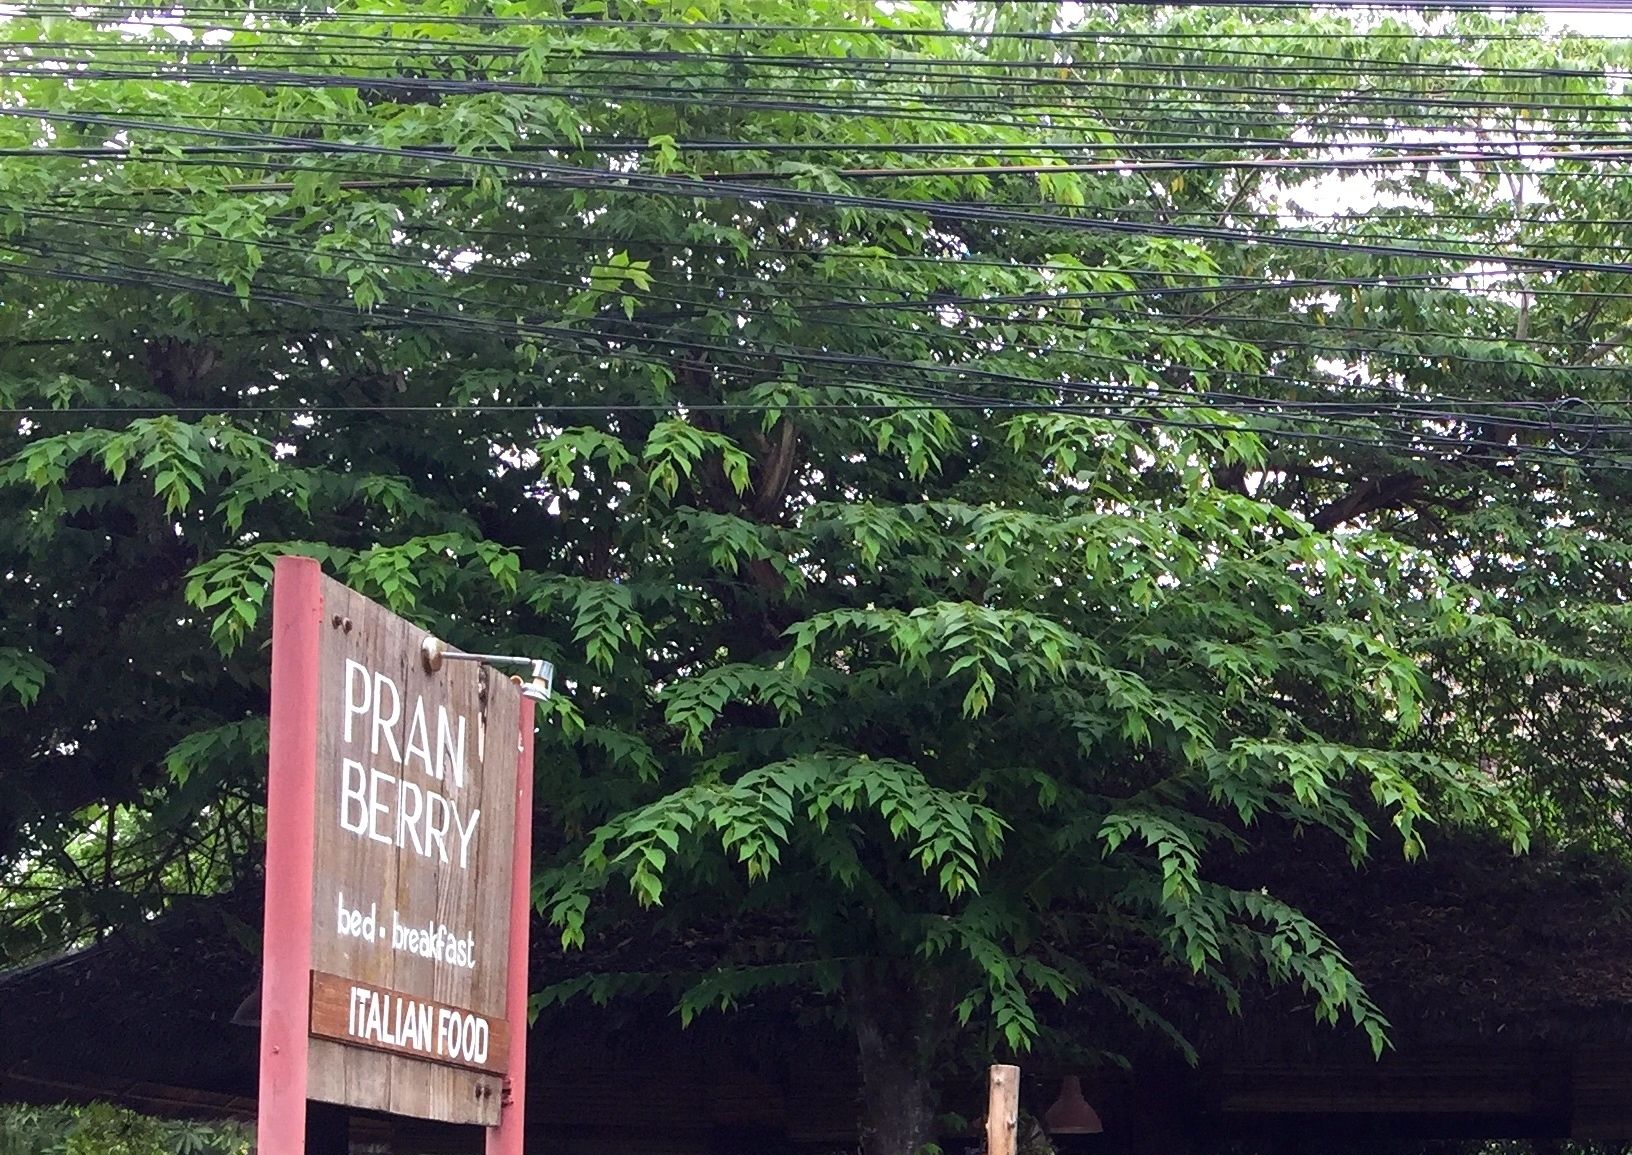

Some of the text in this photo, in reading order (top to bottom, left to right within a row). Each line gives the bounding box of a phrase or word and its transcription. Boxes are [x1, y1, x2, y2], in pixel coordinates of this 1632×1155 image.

[344, 658, 466, 788] PRAN
[340, 757, 481, 869] BERRY
[337, 891, 477, 968] bed breakfast
[349, 986, 489, 1065] ITALIAN FOOD
